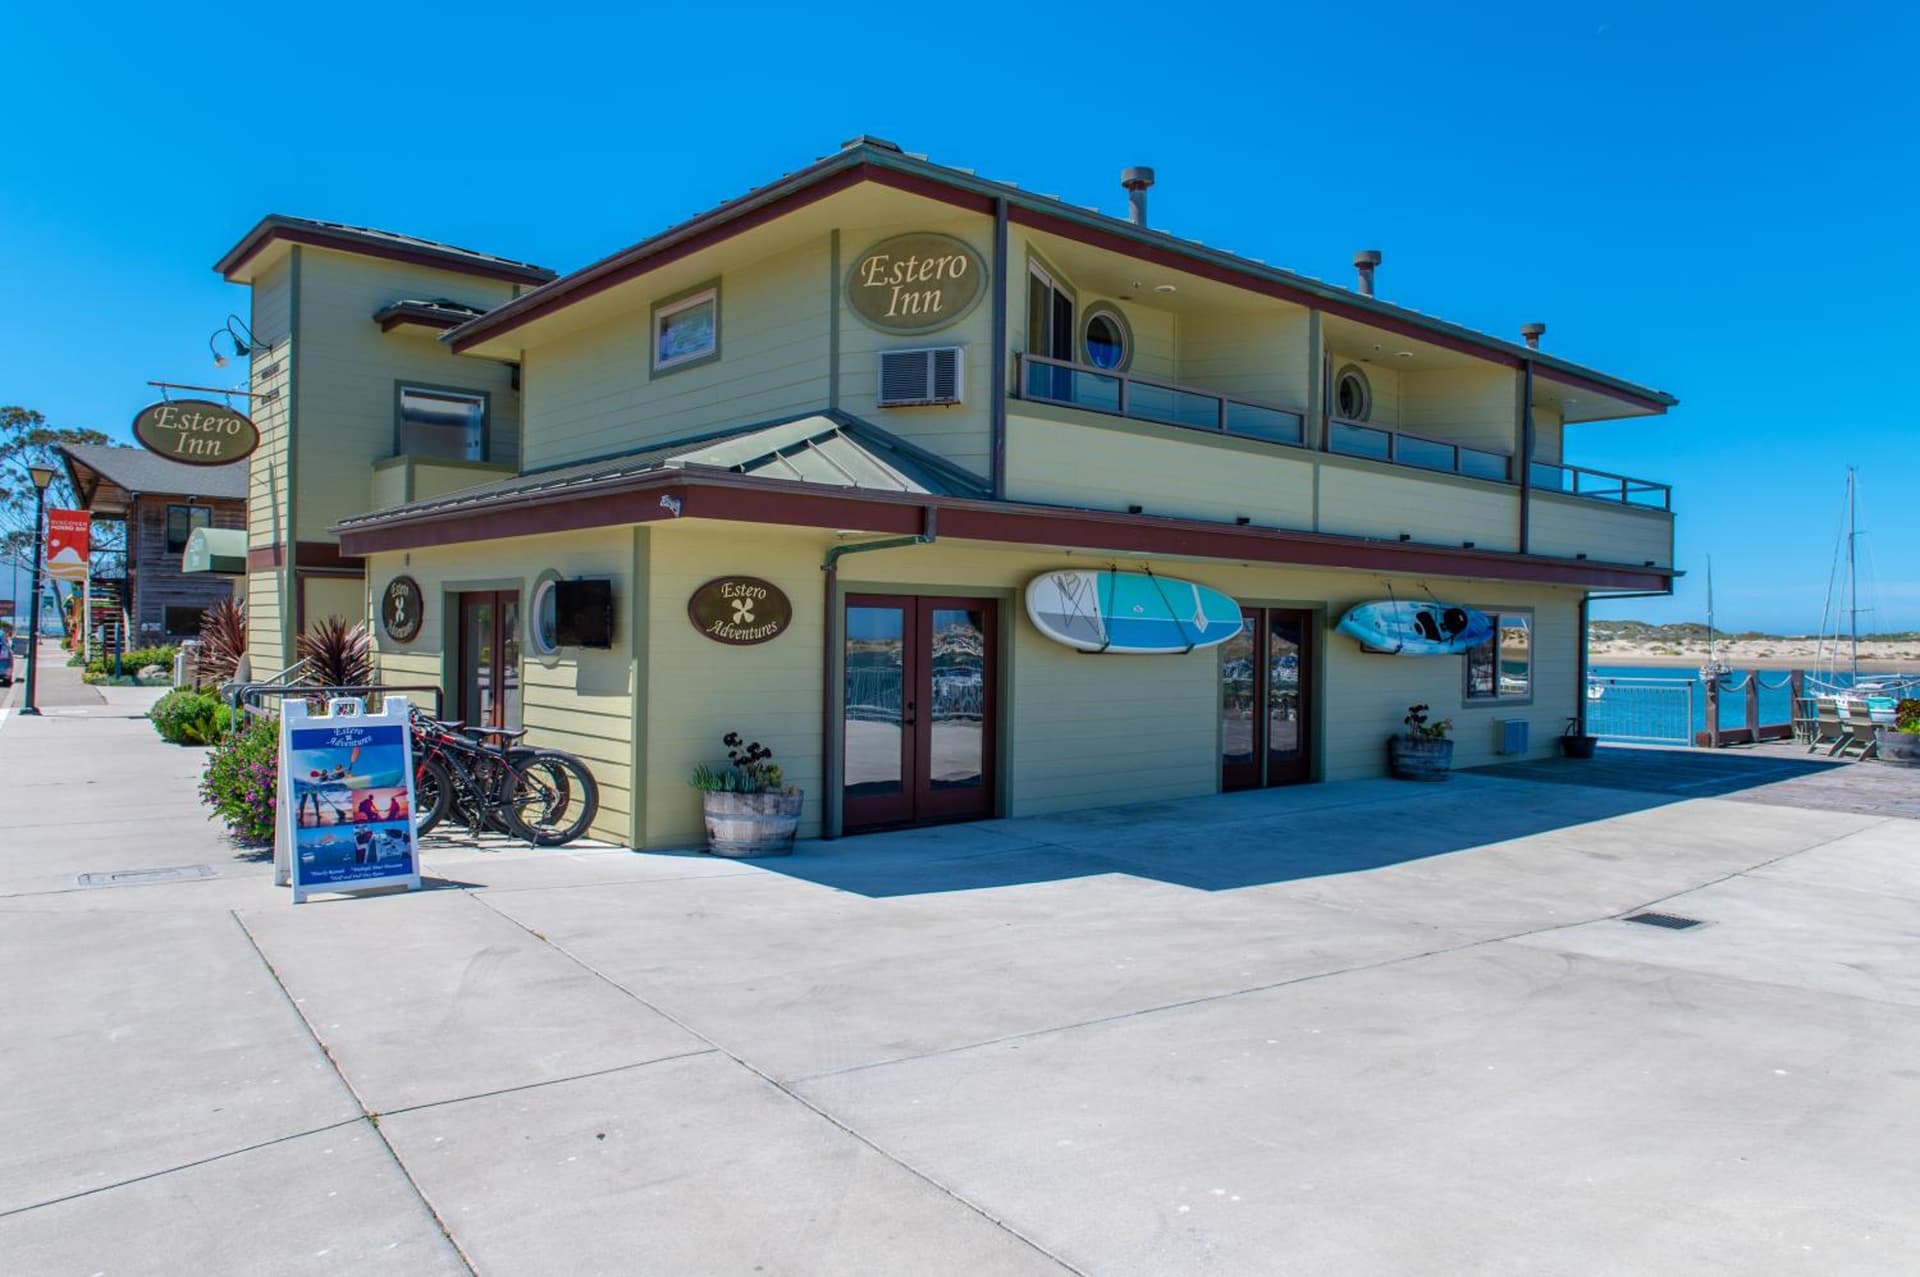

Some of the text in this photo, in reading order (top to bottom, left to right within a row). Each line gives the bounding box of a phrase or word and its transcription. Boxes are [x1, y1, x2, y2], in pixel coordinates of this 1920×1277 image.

[861, 254, 968, 287] Estero
[884, 285, 943, 317] Inn
[153, 406, 241, 435] Estero
[174, 432, 222, 456] Inn
[721, 582, 767, 600] Estero
[706, 619, 778, 641] Adventures
[325, 735, 373, 748] Adventures
[333, 726, 364, 736] Estero
